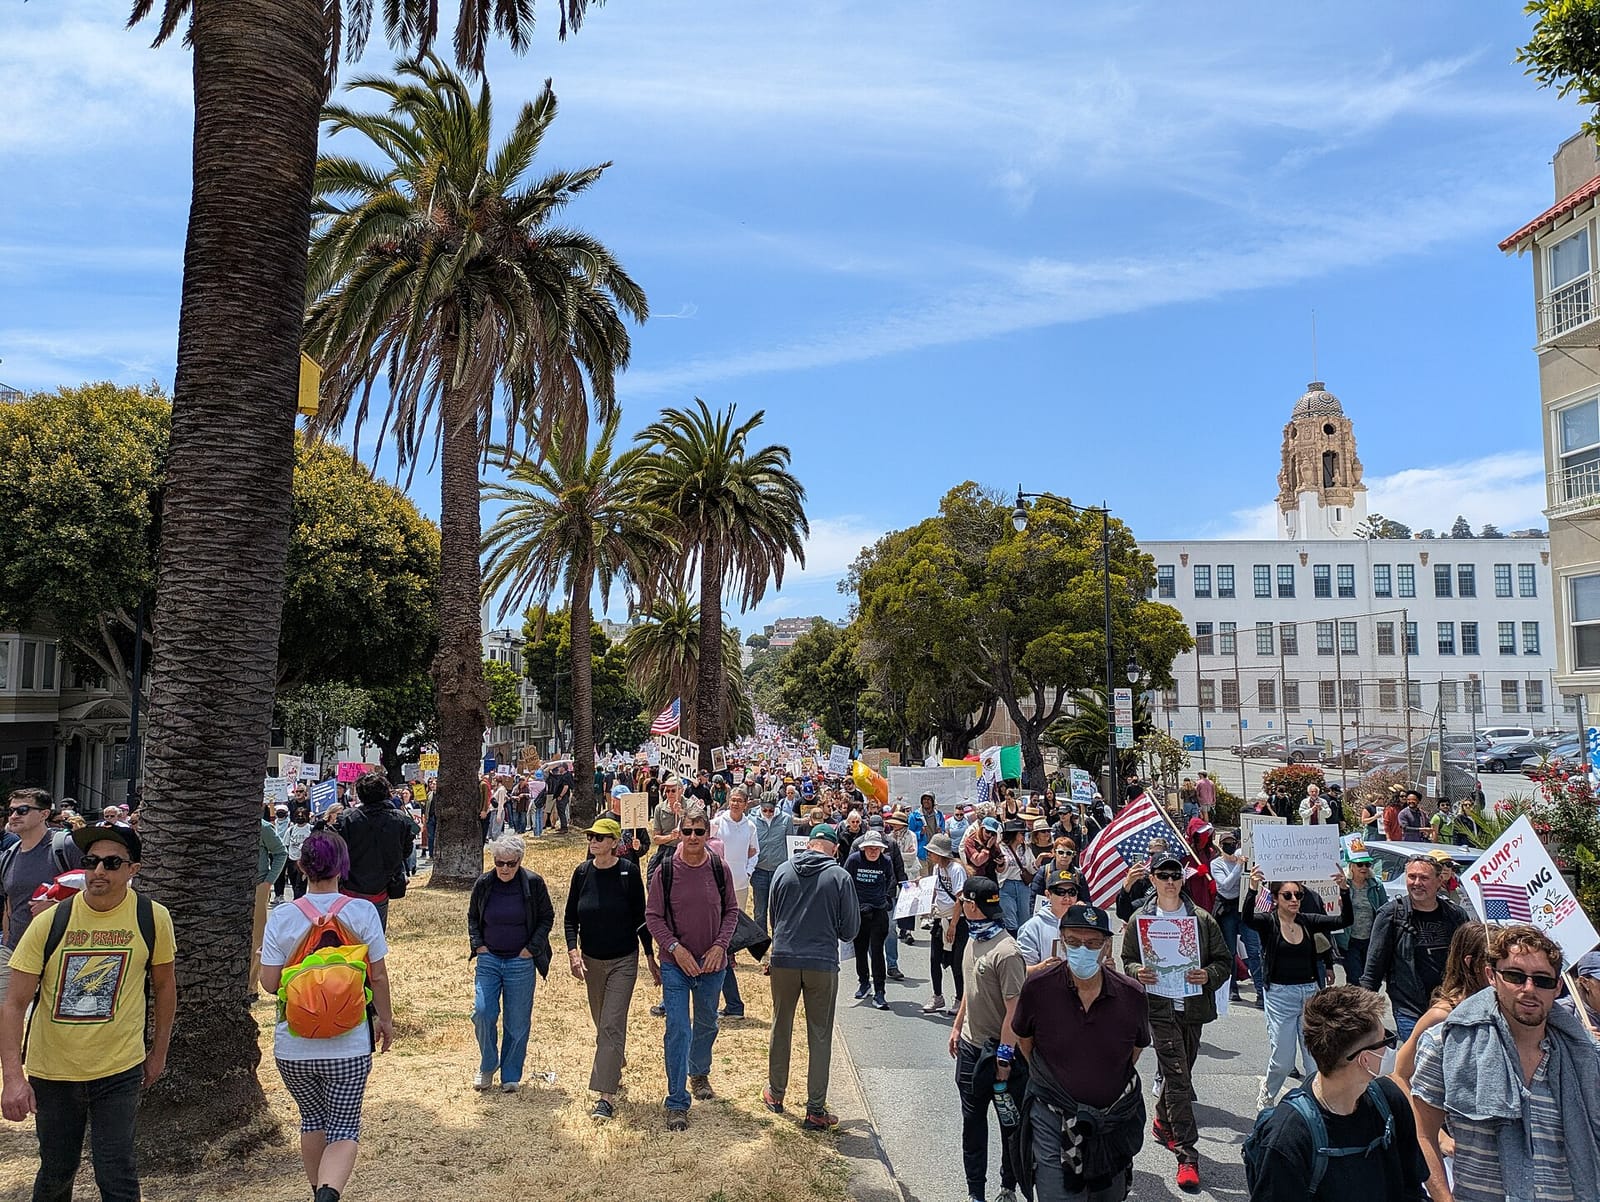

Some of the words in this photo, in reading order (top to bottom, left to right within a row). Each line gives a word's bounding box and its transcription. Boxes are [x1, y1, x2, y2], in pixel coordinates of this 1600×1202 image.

[523, 747, 536, 756] NO
[661, 734, 697, 760] DISSENT
[660, 752, 697, 780] PATRIOTIC
[1261, 832, 1280, 849] Not
[1283, 831, 1296, 848] all
[1258, 852, 1273, 861] are
[1272, 862, 1305, 876] president
[1526, 866, 1553, 900] ING
[64, 930, 90, 947] BAD
[91, 928, 135, 947] BRAINS
